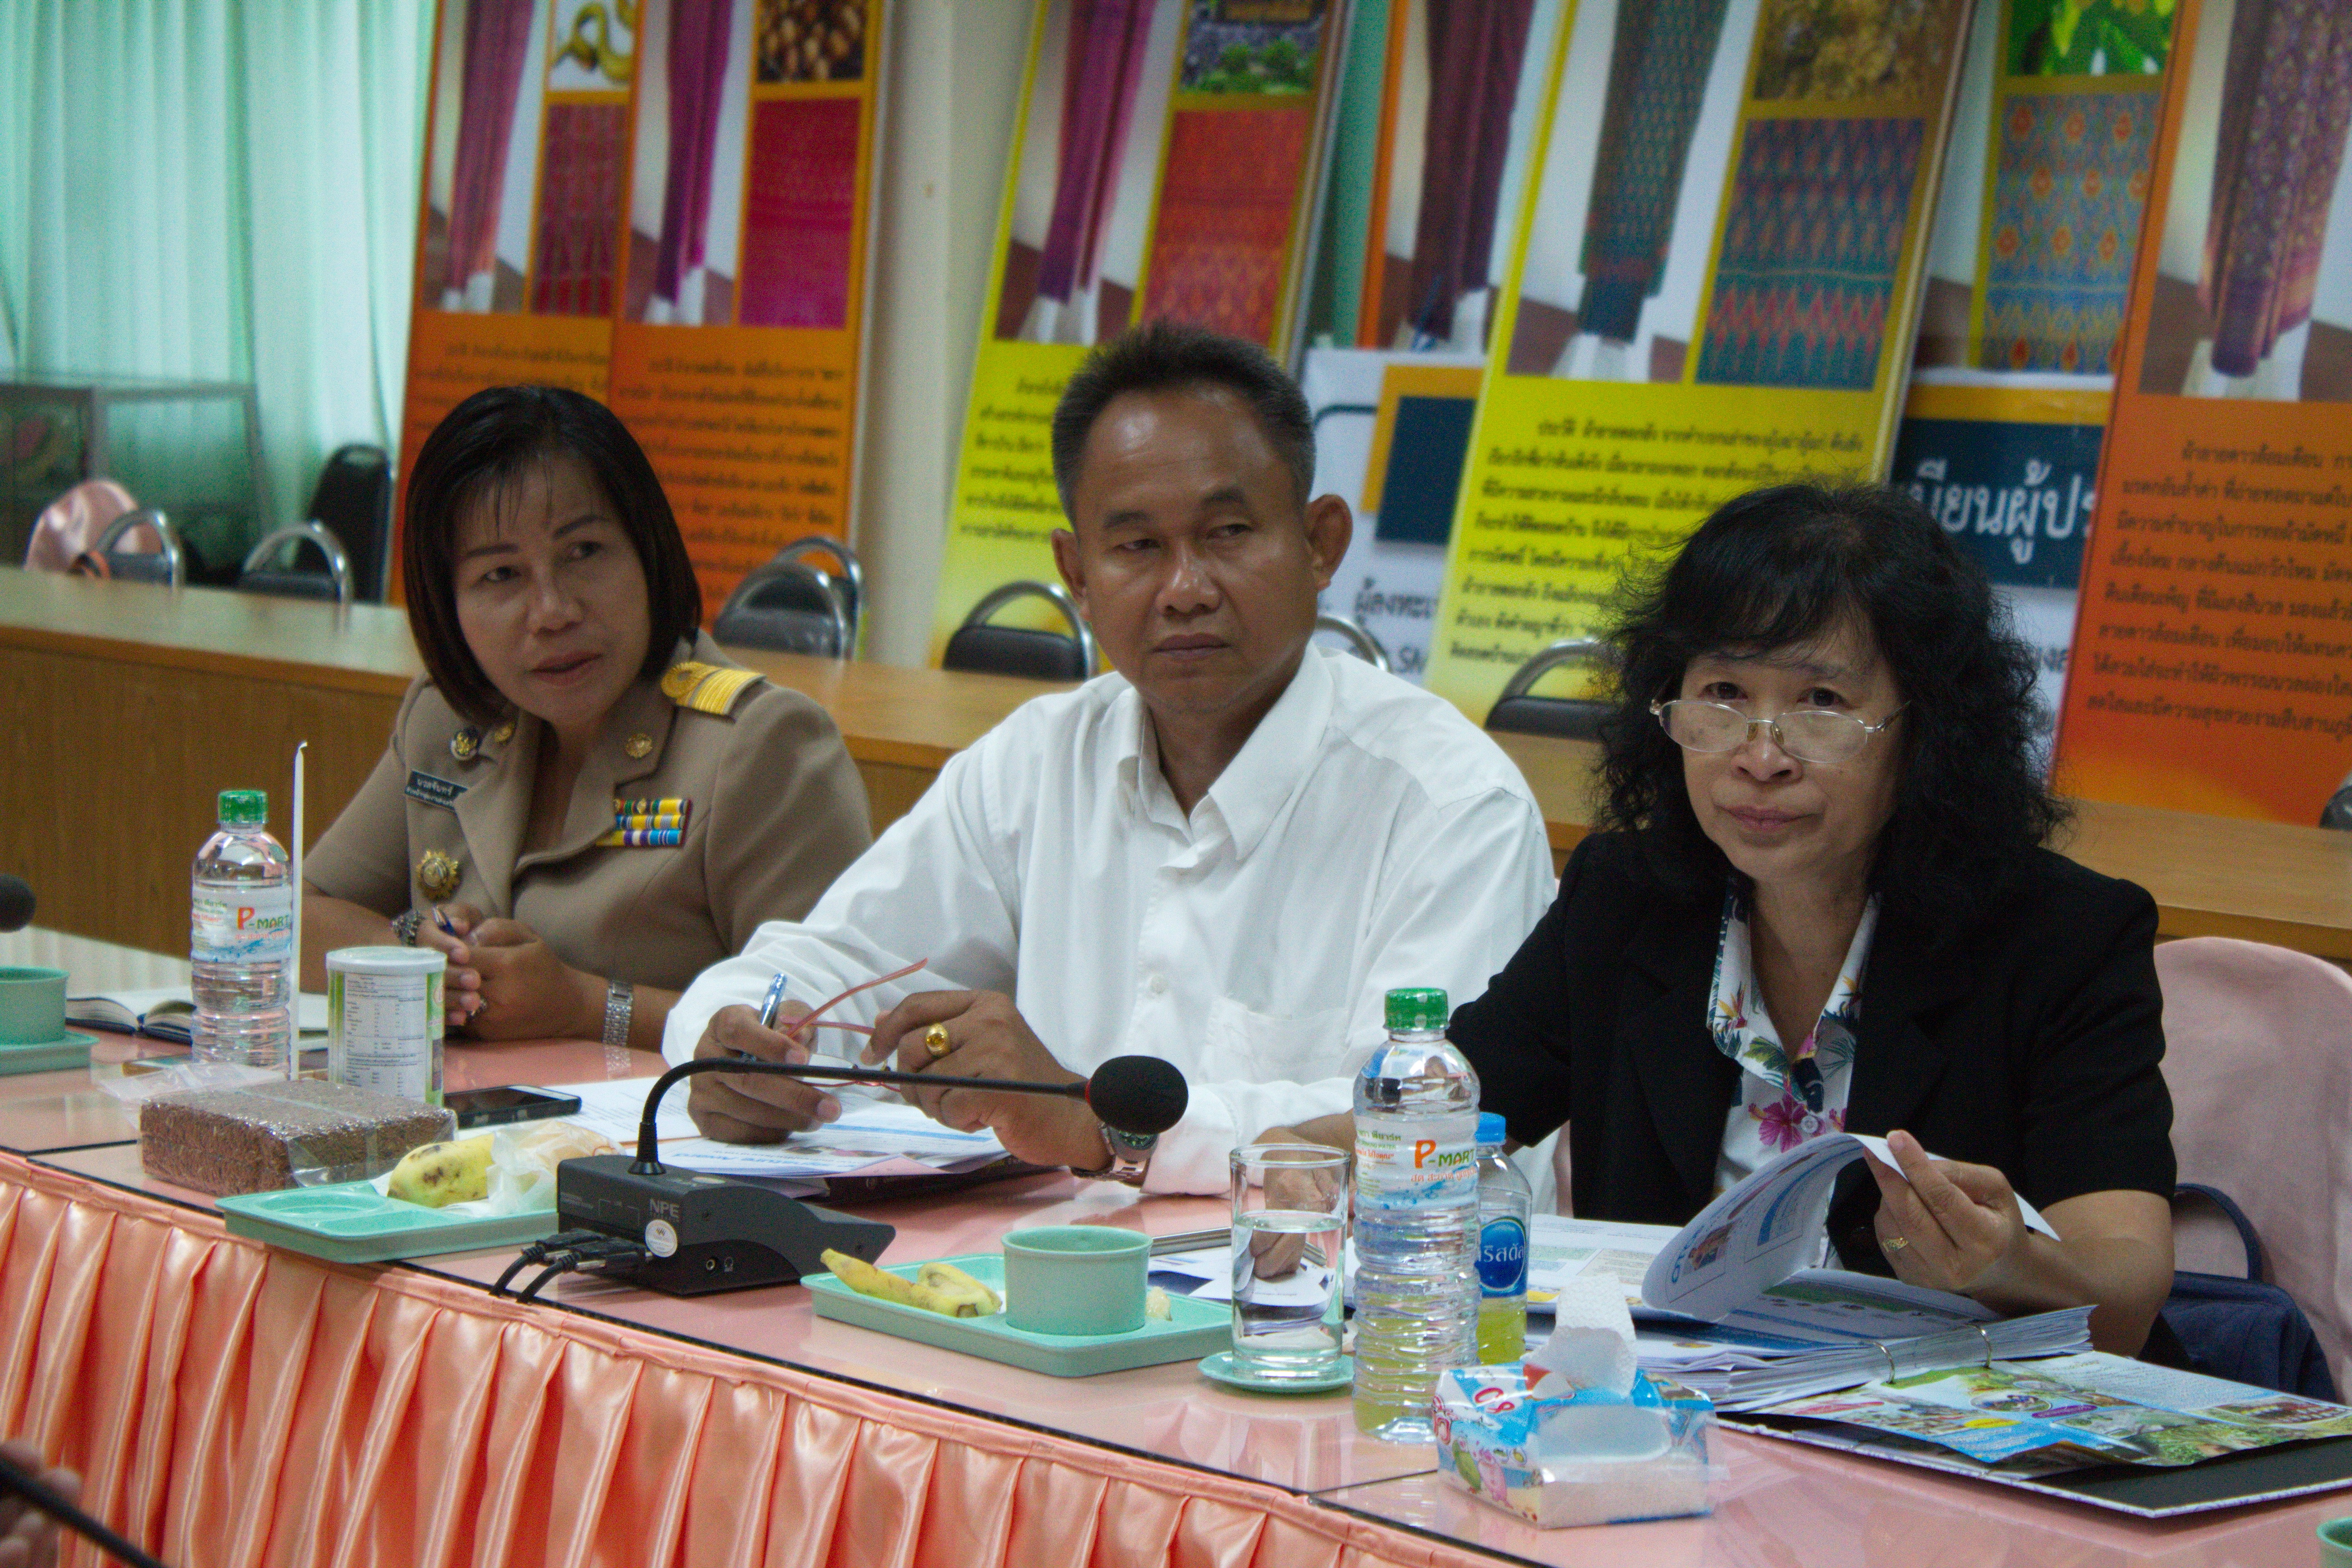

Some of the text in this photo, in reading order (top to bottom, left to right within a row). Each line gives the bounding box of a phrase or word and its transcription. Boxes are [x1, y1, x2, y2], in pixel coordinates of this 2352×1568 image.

[237, 906, 289, 930] P-MART
[1414, 1139, 1475, 1168] P-MART
[649, 1198, 680, 1218] NPE
[1478, 1242, 1525, 1263] ริสตัล
